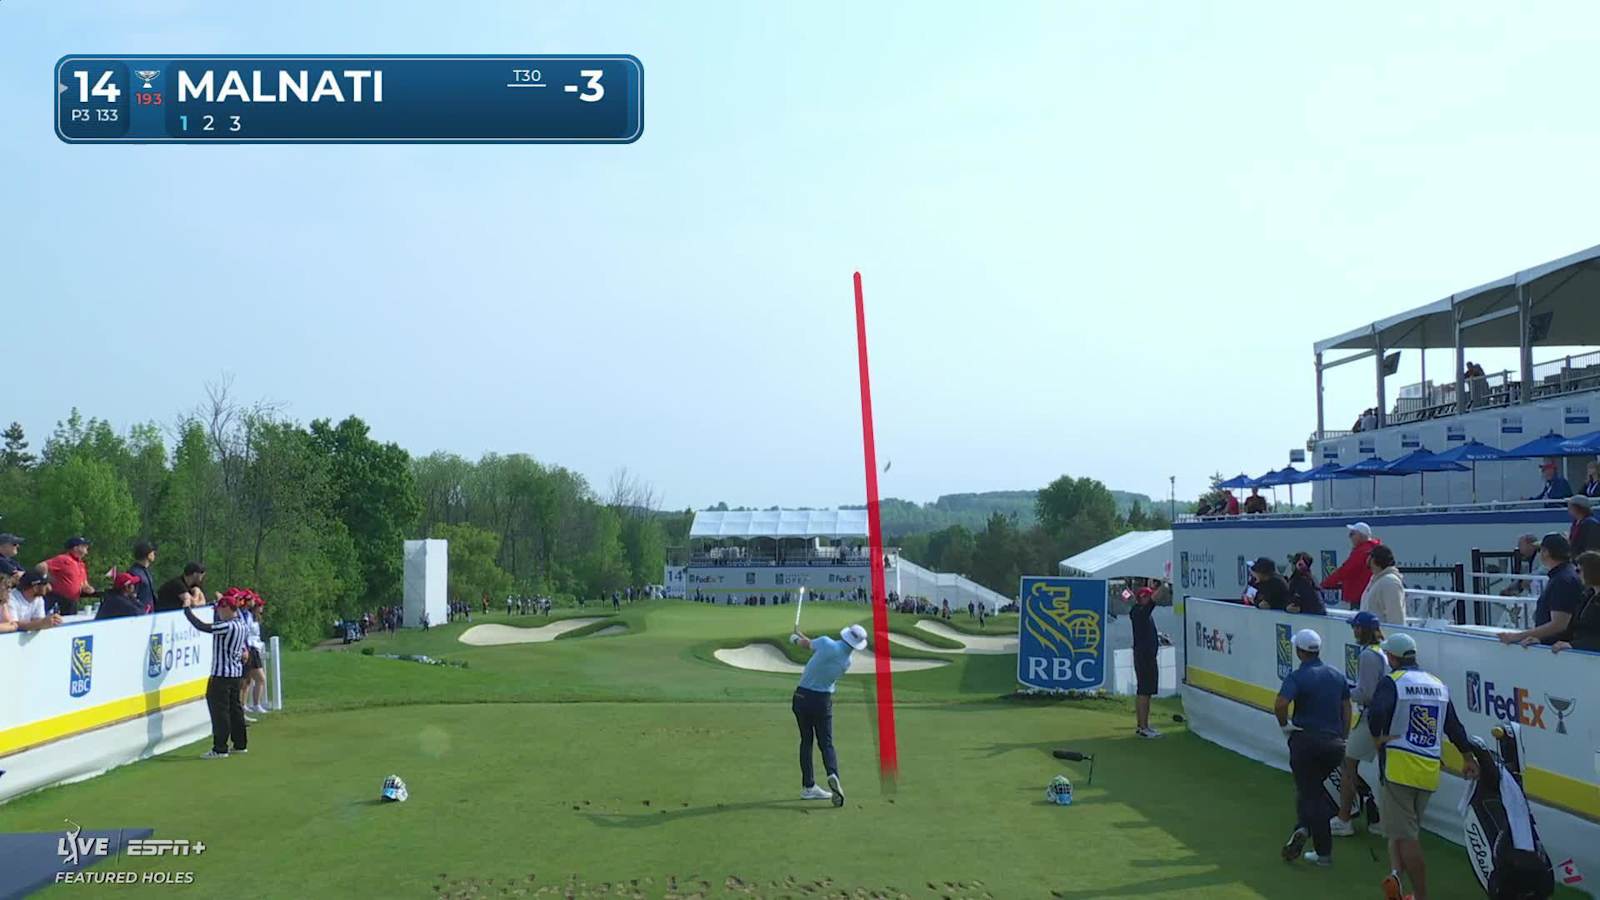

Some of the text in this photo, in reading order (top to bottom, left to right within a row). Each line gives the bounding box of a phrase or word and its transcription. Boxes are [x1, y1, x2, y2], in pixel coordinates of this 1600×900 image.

[668, 571, 682, 582] 14
[1191, 568, 1215, 589] OPEN
[1202, 628, 1225, 653] FedEx
[165, 645, 200, 671] OPEN
[1028, 656, 1095, 682] RBC
[71, 678, 90, 694] RBC
[1484, 681, 1546, 730] FedEx
[1409, 733, 1434, 746] RBC
[1466, 823, 1491, 880] Titleis
